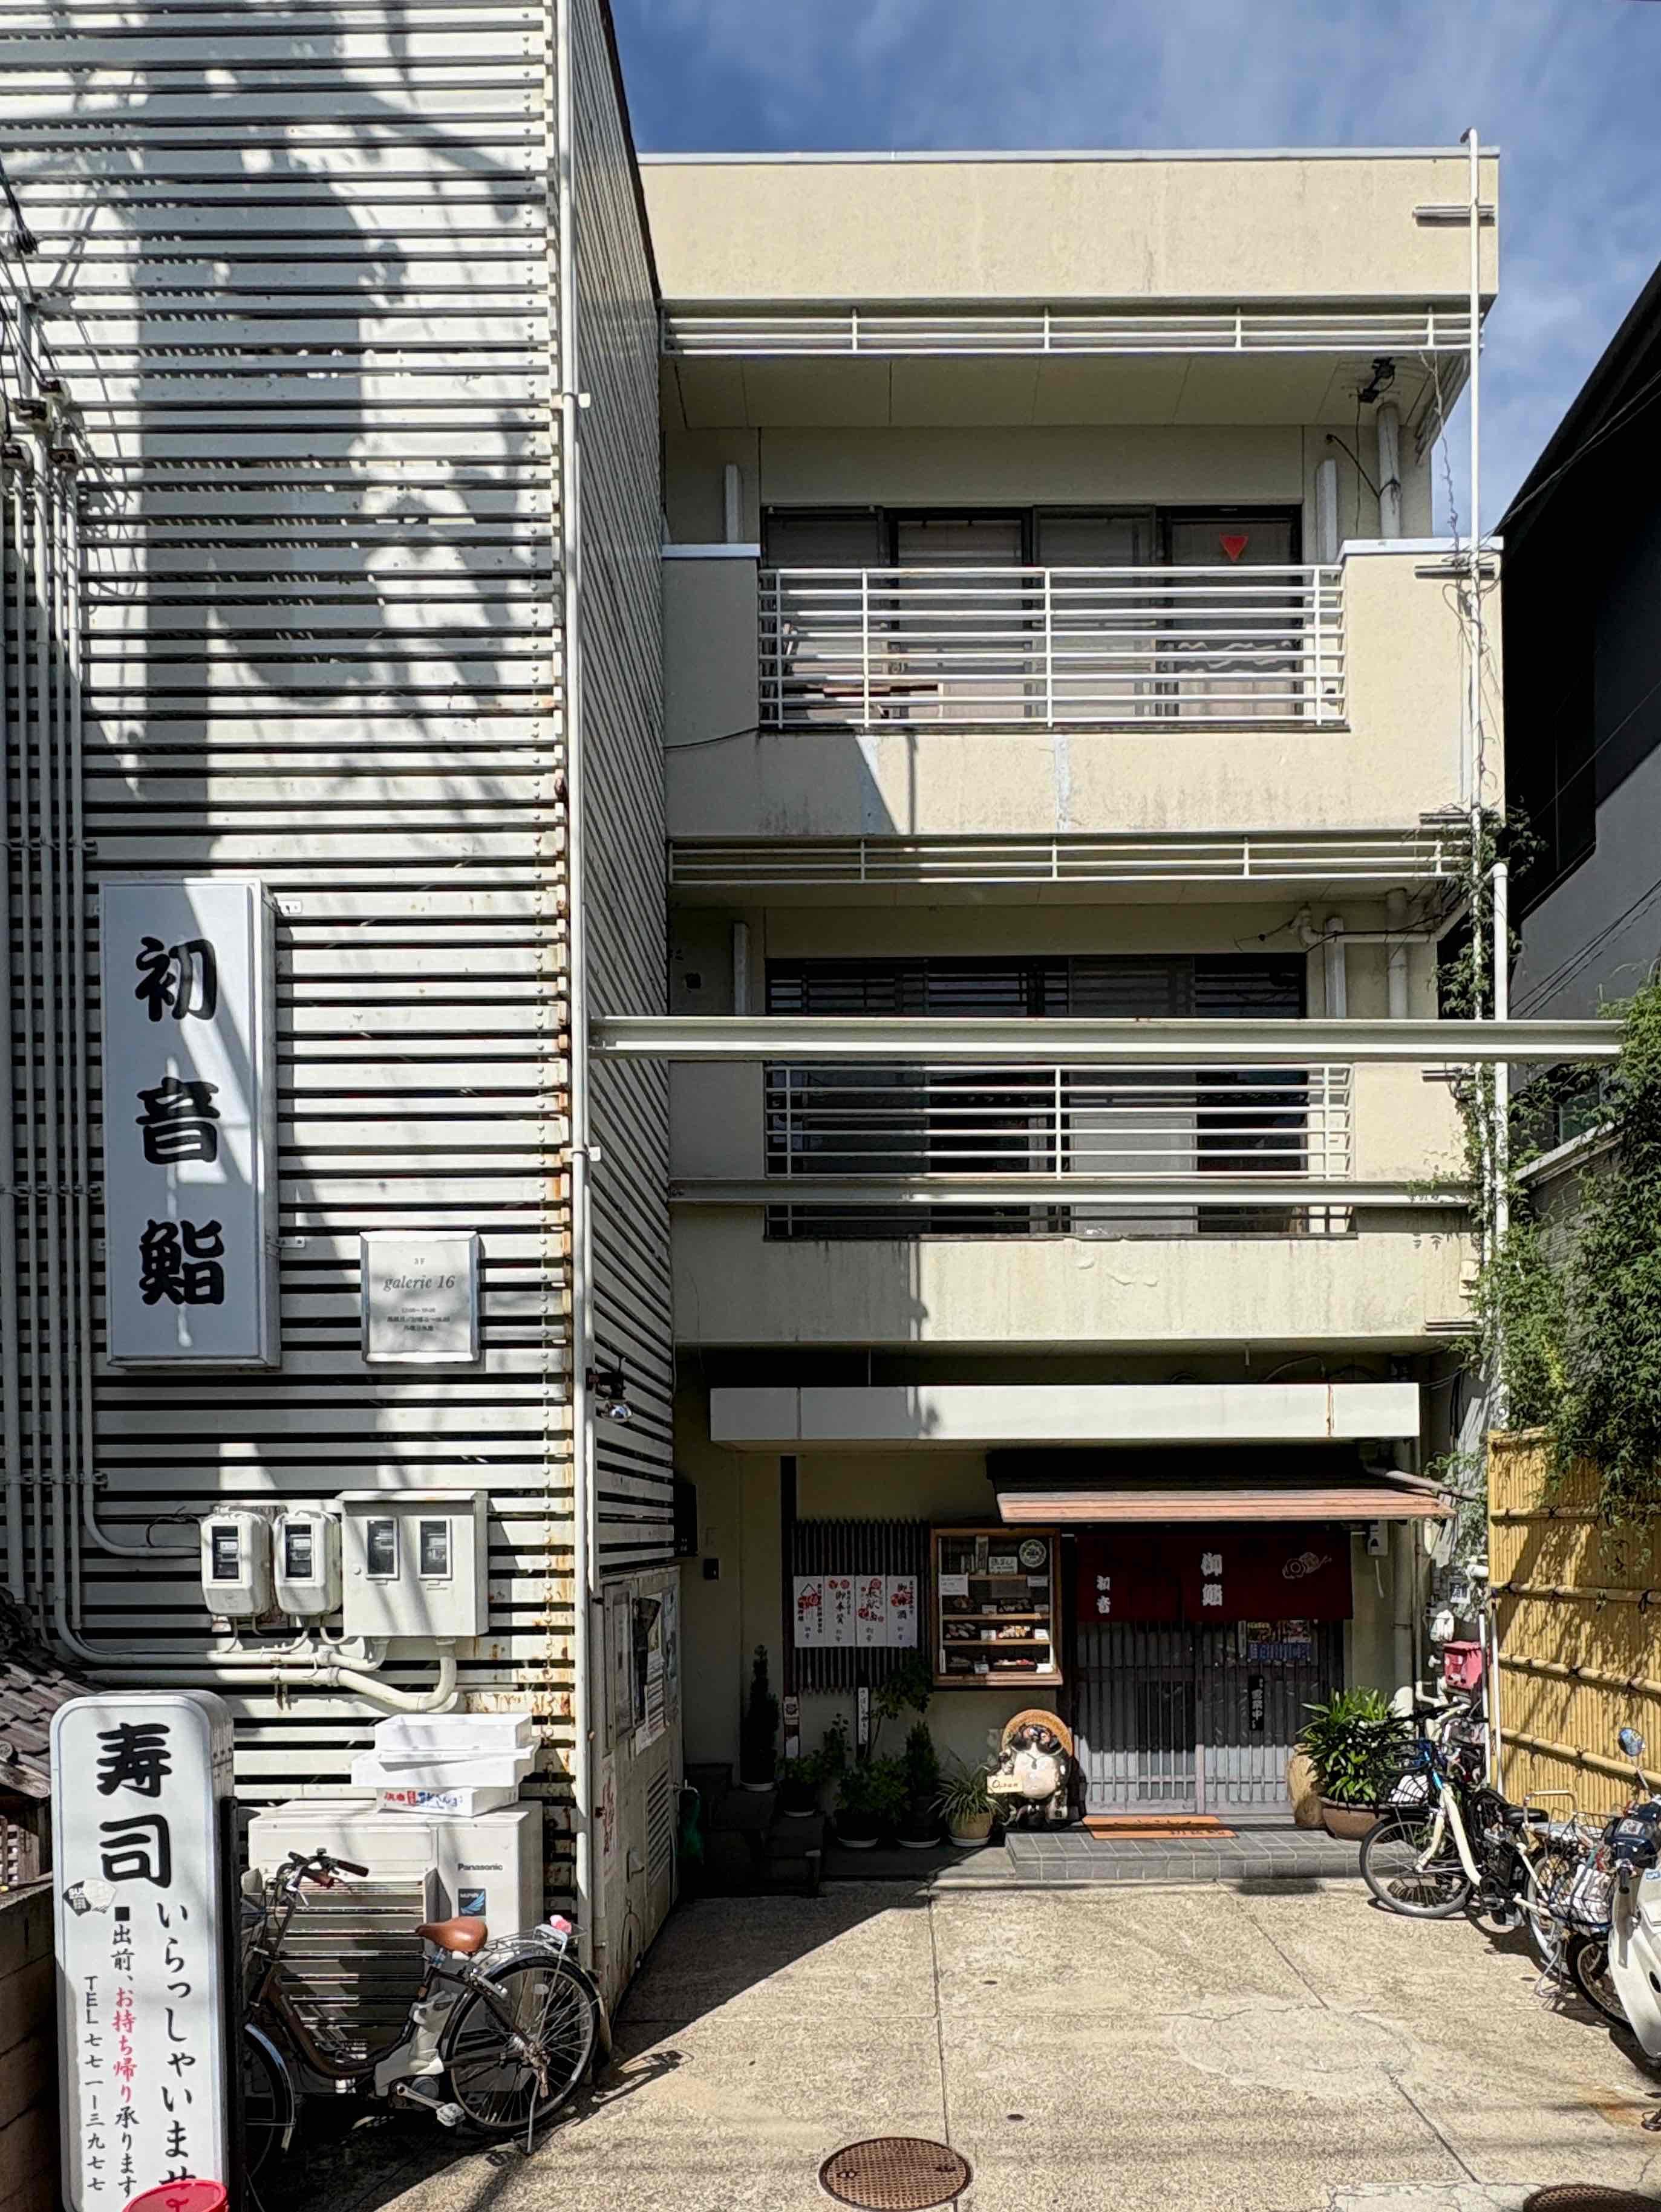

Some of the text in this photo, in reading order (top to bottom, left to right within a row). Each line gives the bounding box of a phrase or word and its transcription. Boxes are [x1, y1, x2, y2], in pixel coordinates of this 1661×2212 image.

[135, 936, 224, 1306] 初音鮨
[383, 1275, 455, 1292] galerie 16
[96, 1722, 172, 1888] 寿司
[458, 1862, 503, 1871] Panasonic
